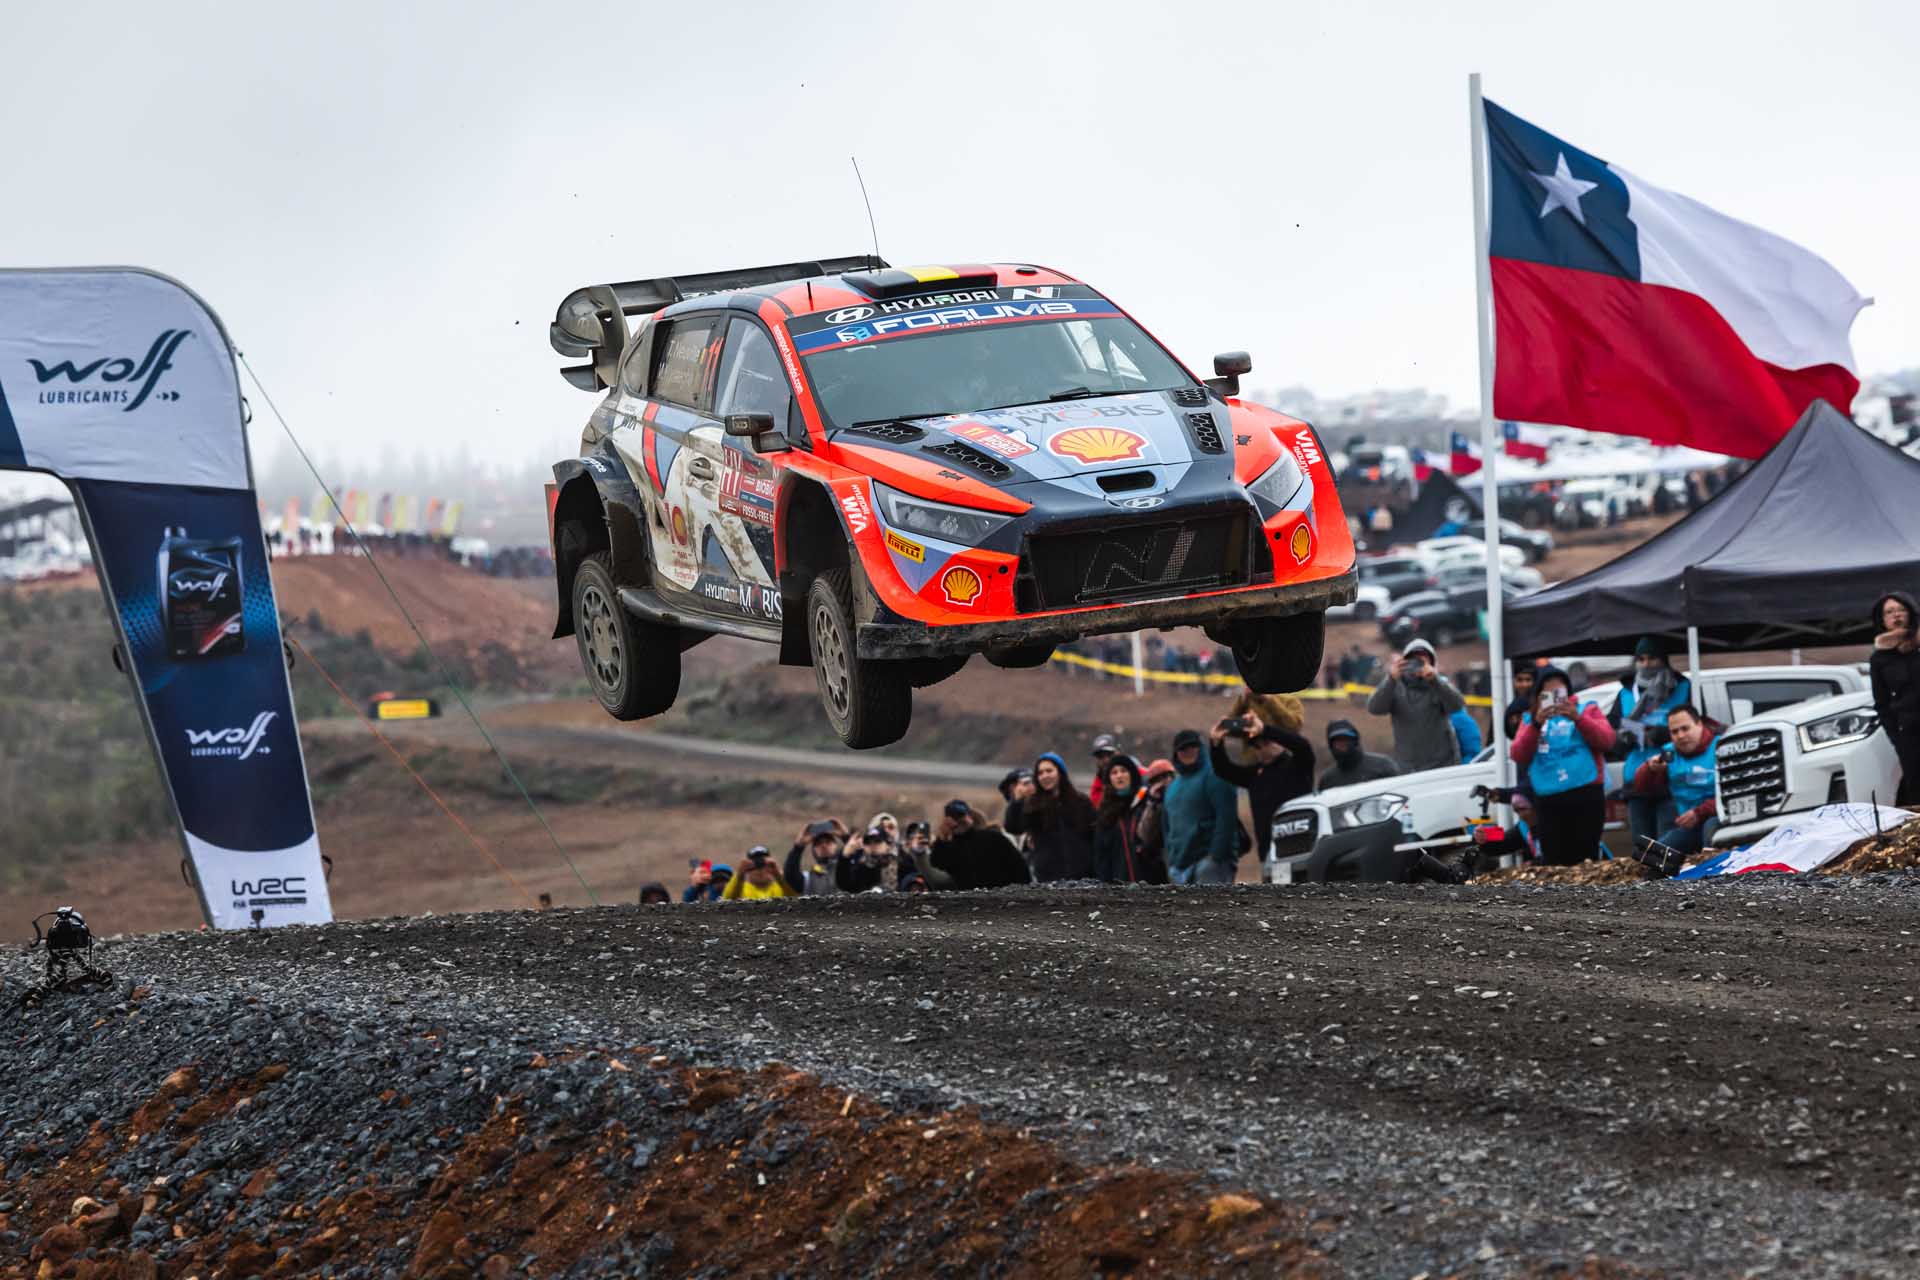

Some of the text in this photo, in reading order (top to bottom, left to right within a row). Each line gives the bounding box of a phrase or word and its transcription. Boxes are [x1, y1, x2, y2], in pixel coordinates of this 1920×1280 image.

[883, 290, 1000, 314] HYUNDAI
[872, 303, 1077, 334] FORUM8
[38, 389, 130, 405] LUBRICANTS
[1016, 403, 1165, 427] MOBIS
[887, 533, 921, 559] PIRELLI
[231, 877, 307, 896] WRC
